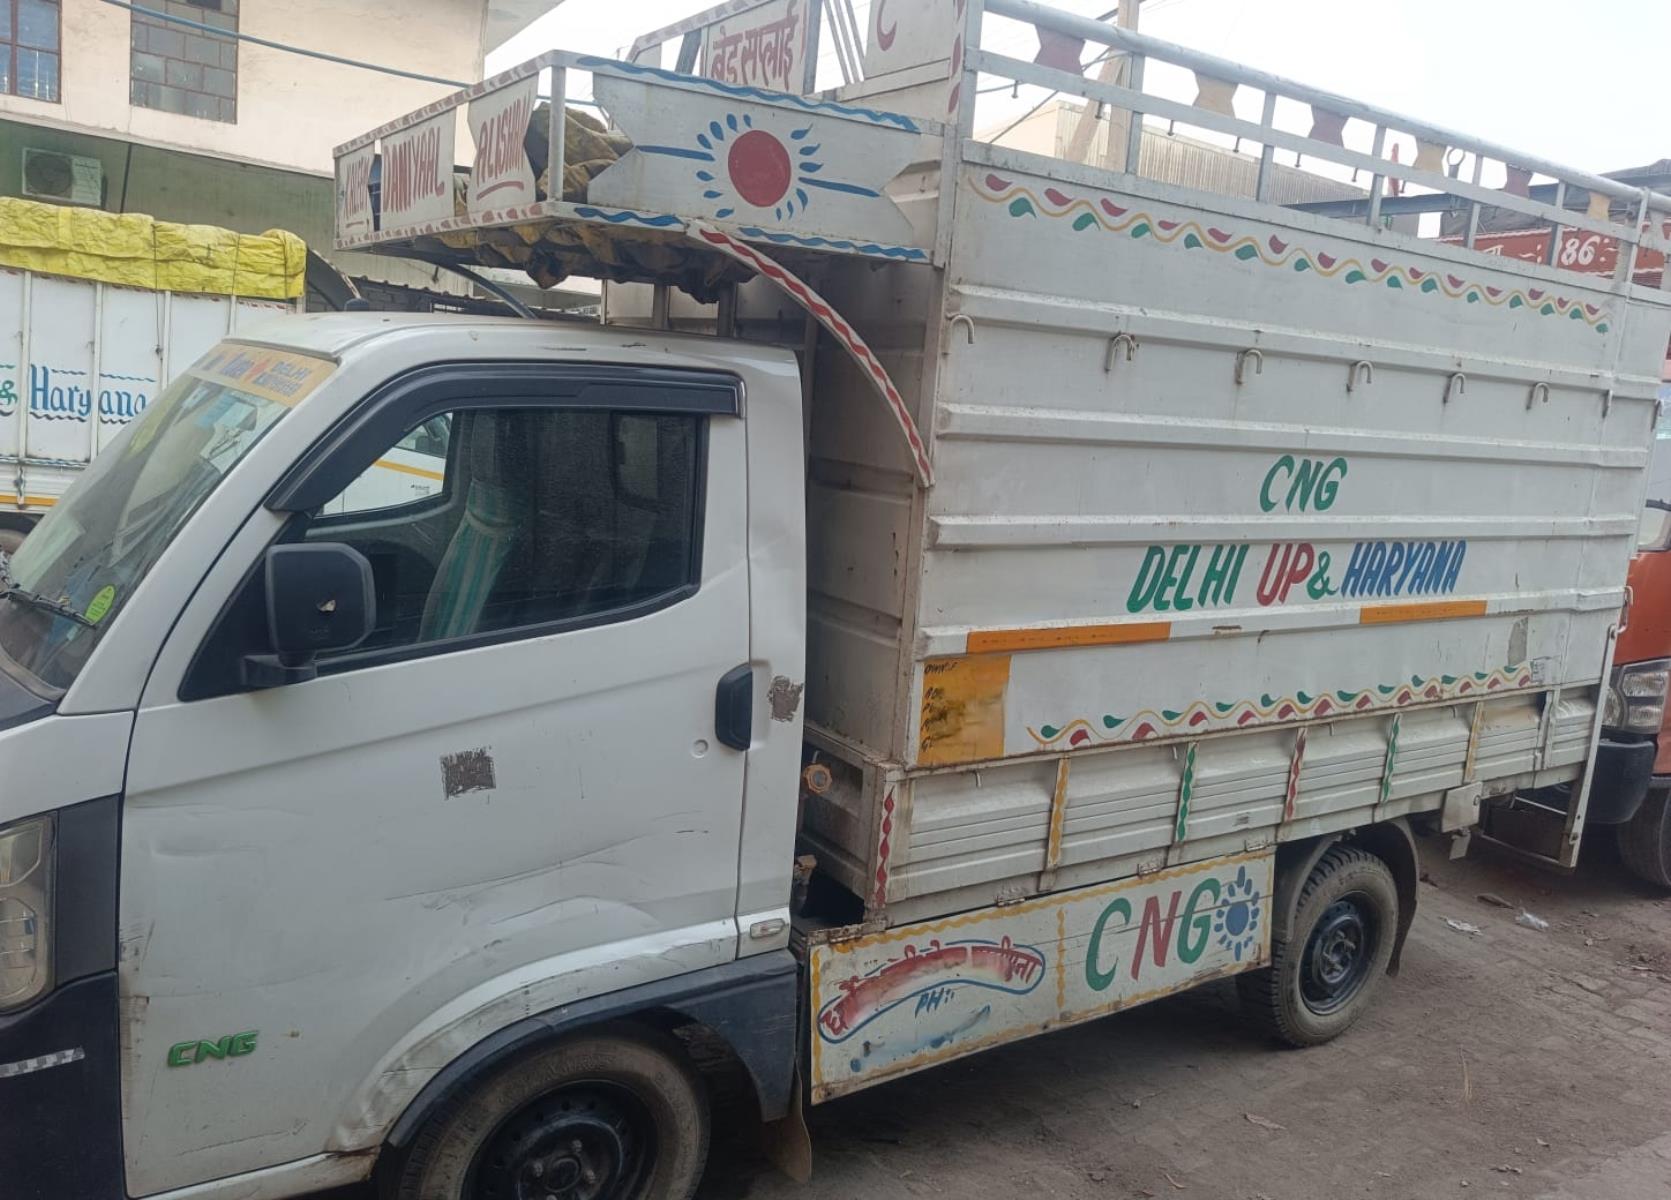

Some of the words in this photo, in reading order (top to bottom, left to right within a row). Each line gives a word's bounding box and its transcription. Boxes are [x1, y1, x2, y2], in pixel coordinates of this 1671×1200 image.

[383, 126, 445, 213] DANIYAAL
[1558, 234, 1601, 266] 86
[30, 363, 147, 417] Haryana
[1259, 454, 1348, 514] CNG
[1126, 543, 1249, 613] DELHI
[1256, 542, 1314, 606] UP
[1341, 539, 1467, 599] HARYANA
[1085, 877, 1222, 992] CNG
[167, 1029, 260, 1069] CNG
